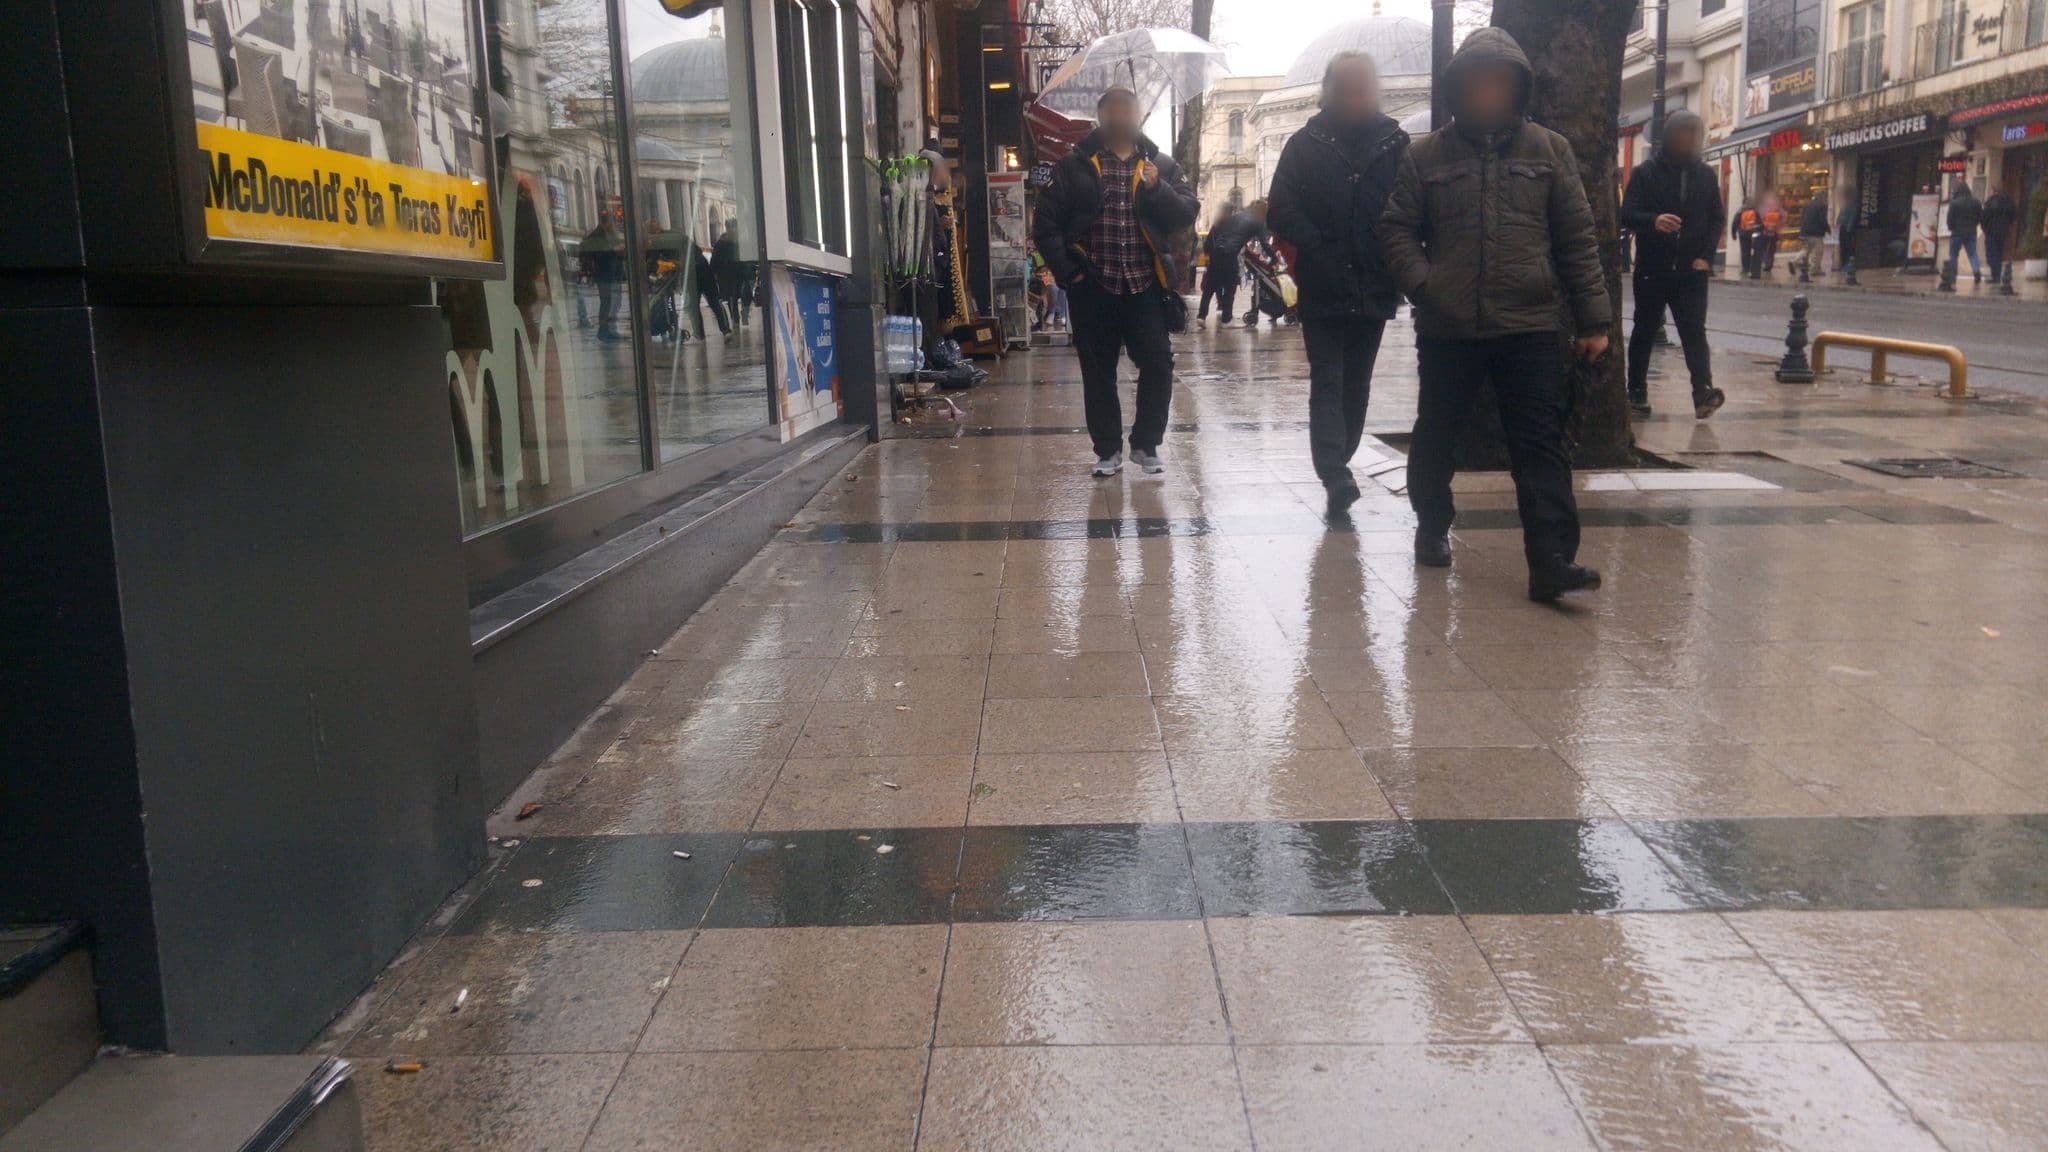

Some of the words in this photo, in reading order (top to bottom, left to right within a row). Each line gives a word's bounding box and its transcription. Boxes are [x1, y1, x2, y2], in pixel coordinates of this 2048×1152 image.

[1770, 67, 1815, 96] COIFFEUR
[1823, 125, 1883, 150] STARBUCKS
[1884, 115, 1927, 138] COFFEE
[1937, 159, 1967, 171] Hotel
[388, 183, 441, 236] Teras
[446, 193, 488, 249] Keyfi
